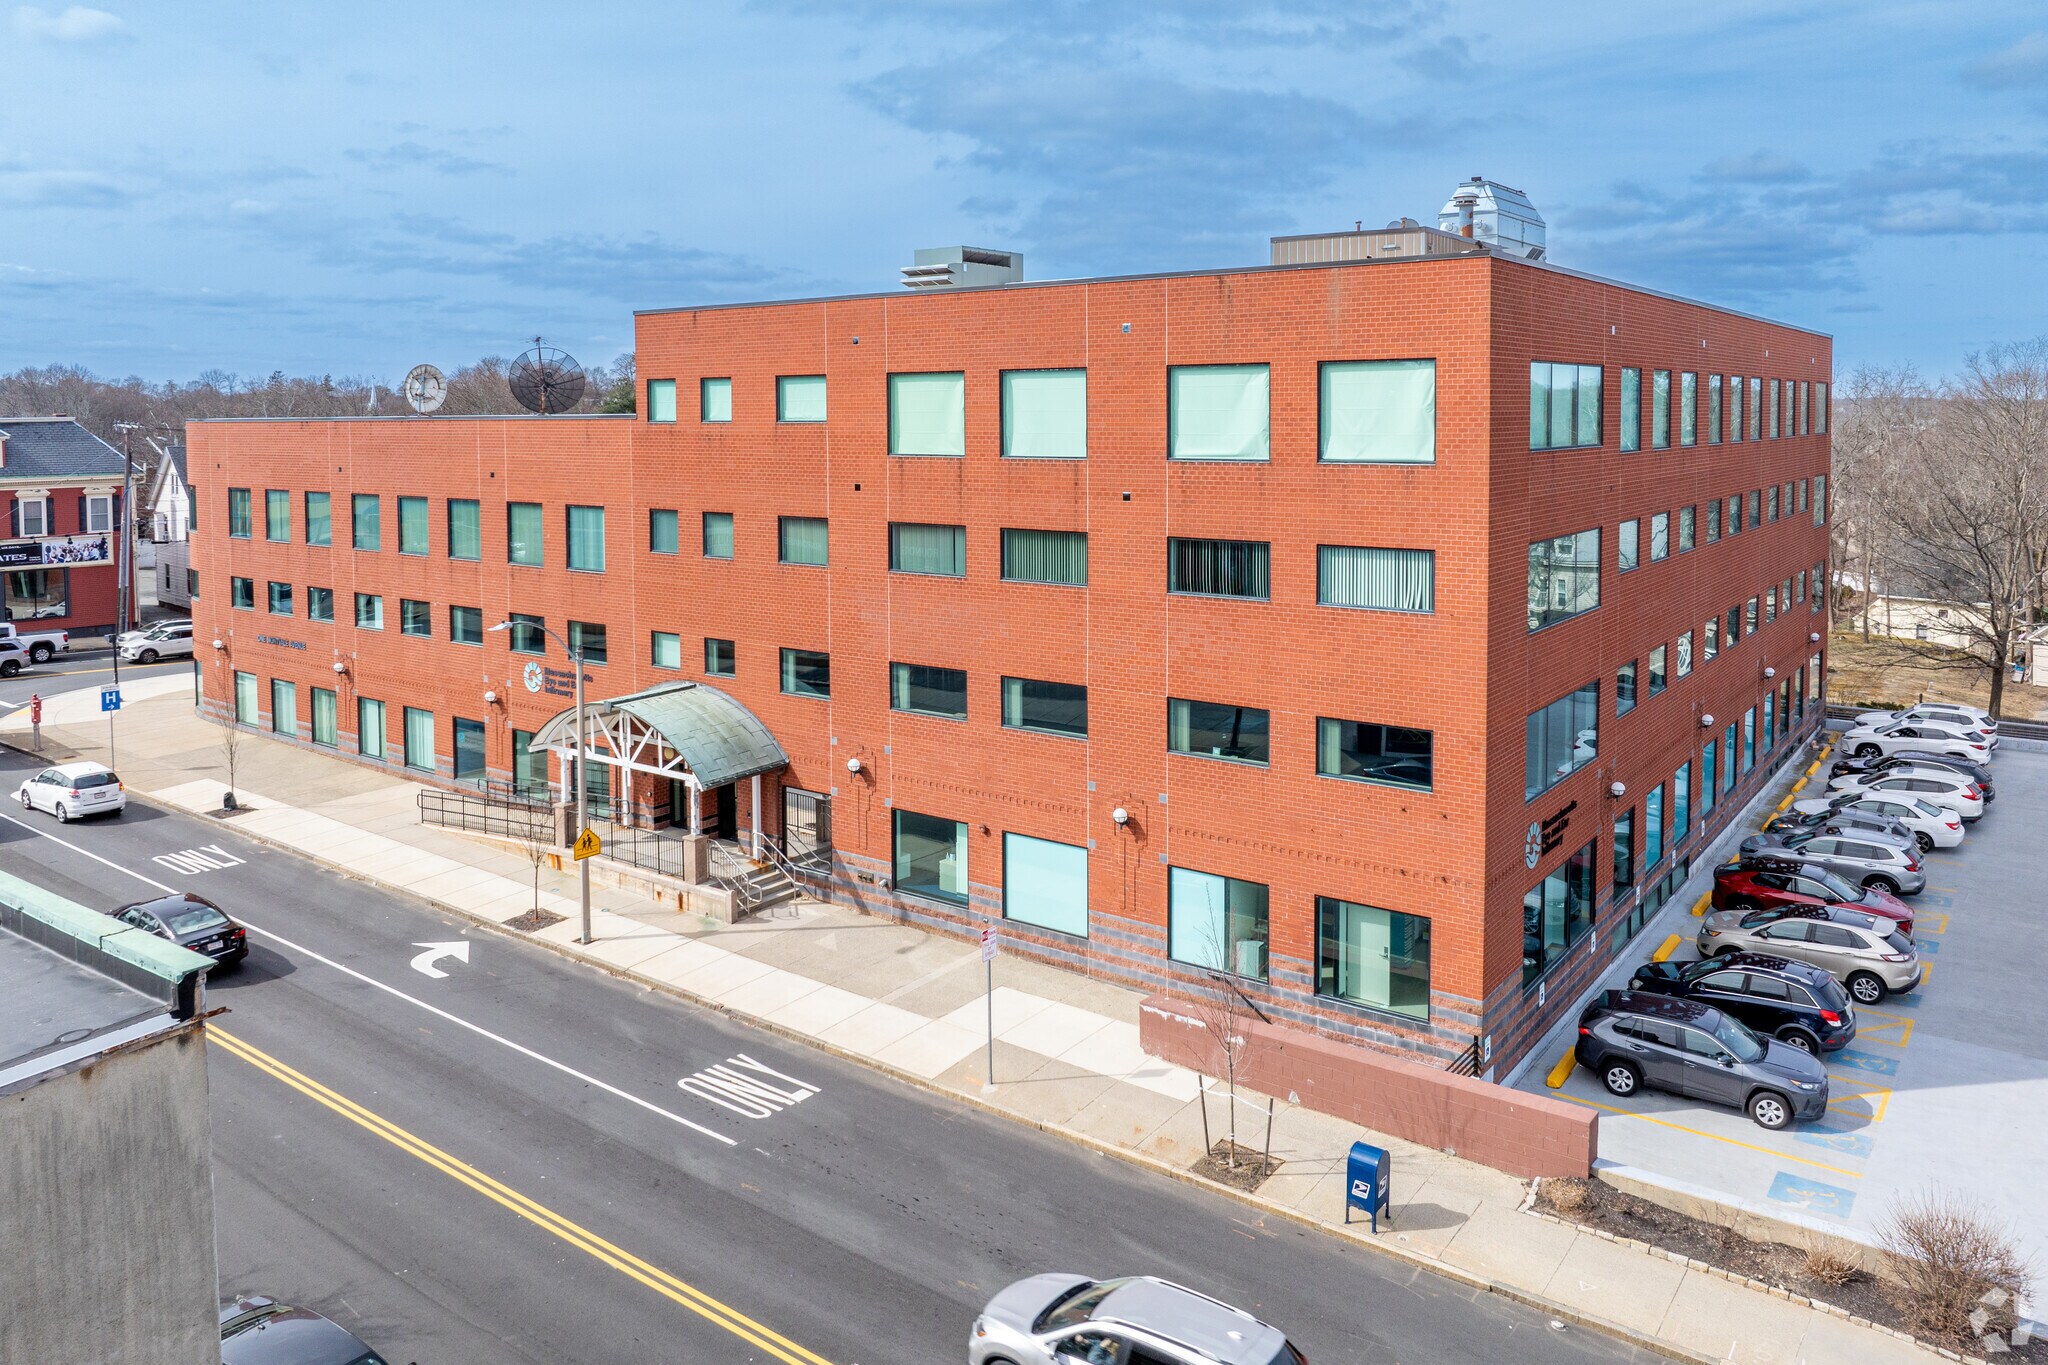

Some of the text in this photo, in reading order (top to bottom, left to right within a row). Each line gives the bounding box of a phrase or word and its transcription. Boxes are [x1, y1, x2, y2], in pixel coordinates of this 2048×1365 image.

[544, 667, 593, 682] Massachutts
[106, 692, 116, 704] H
[151, 844, 247, 875] ONLY
[677, 1053, 822, 1119] ONLY
